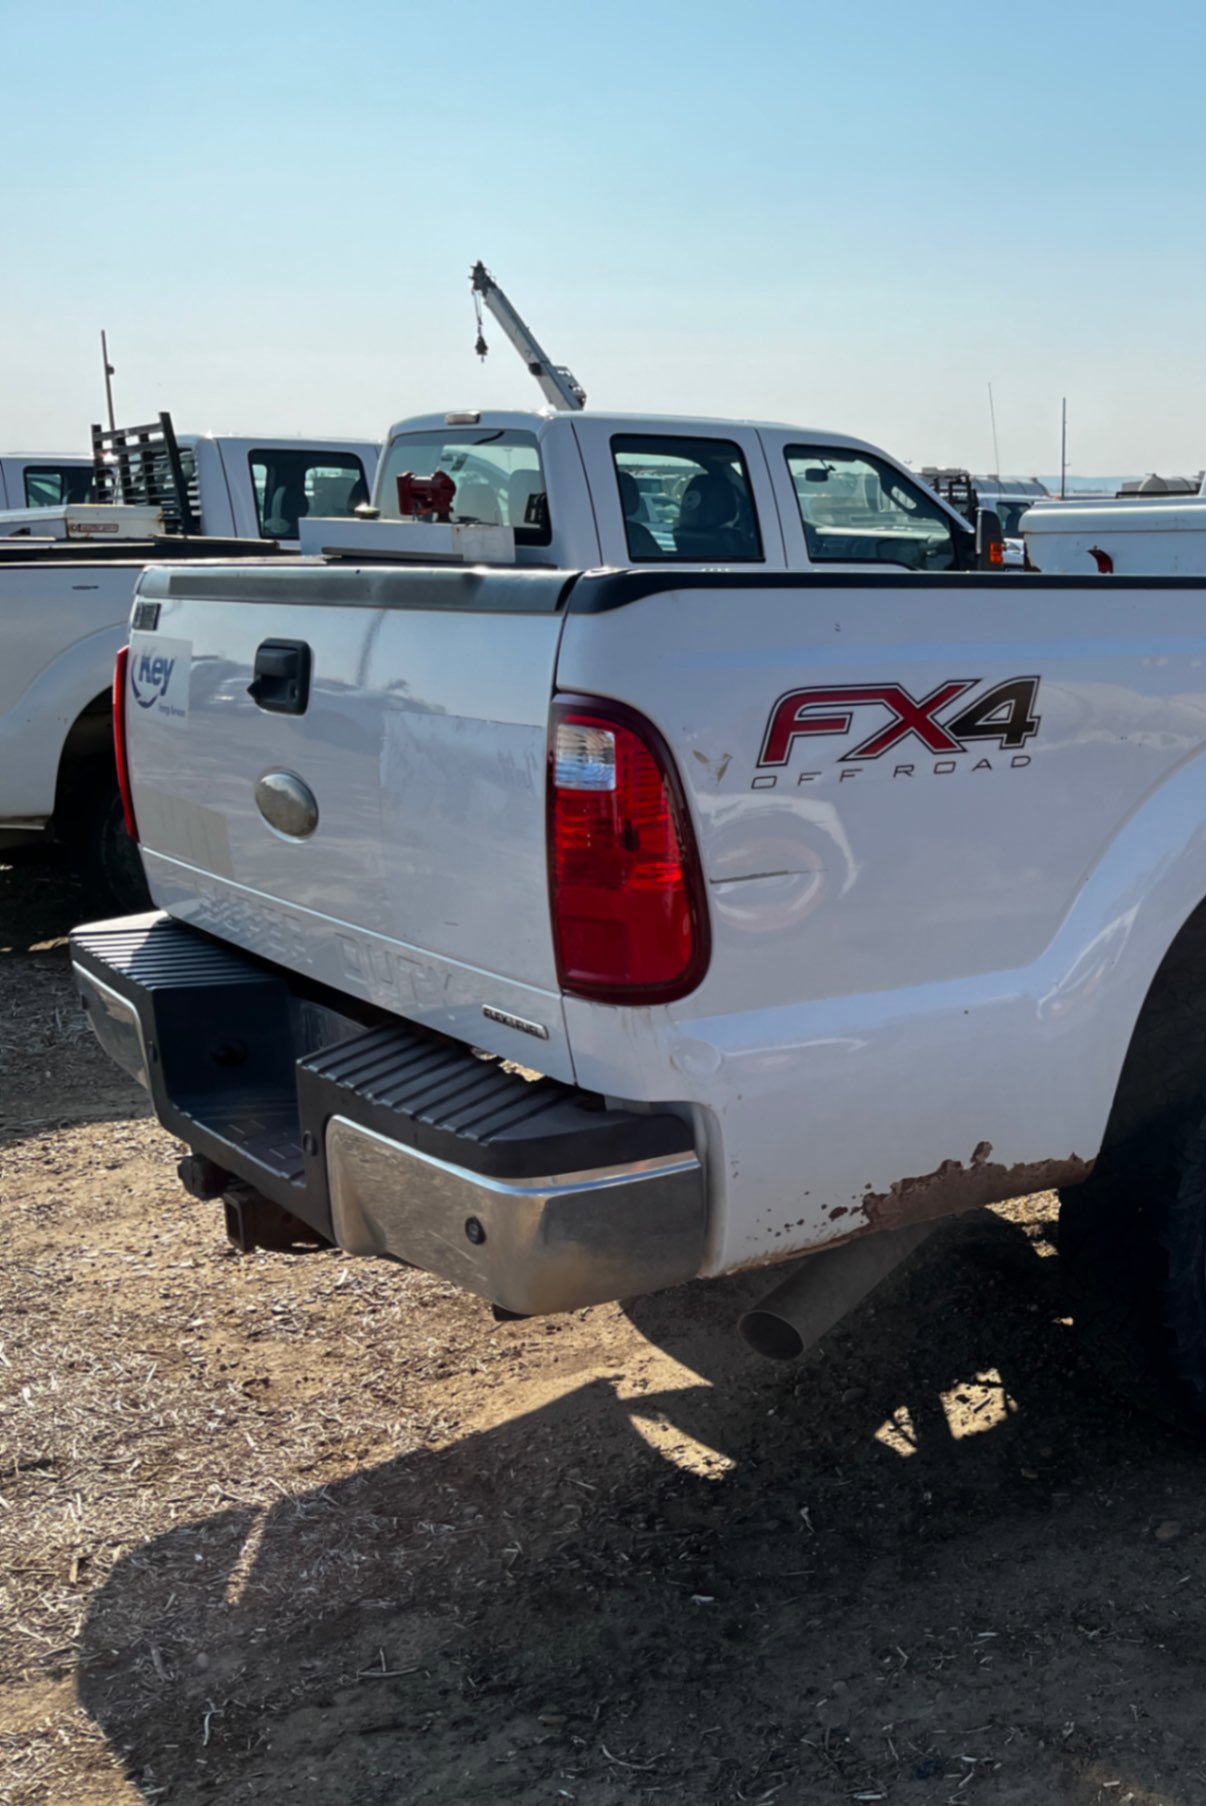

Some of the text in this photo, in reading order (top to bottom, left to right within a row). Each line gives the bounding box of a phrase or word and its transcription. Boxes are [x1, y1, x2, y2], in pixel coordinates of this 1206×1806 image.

[138, 647, 176, 697] Key
[755, 675, 1041, 768] FX4
[751, 755, 1032, 790] OFF ROAD
